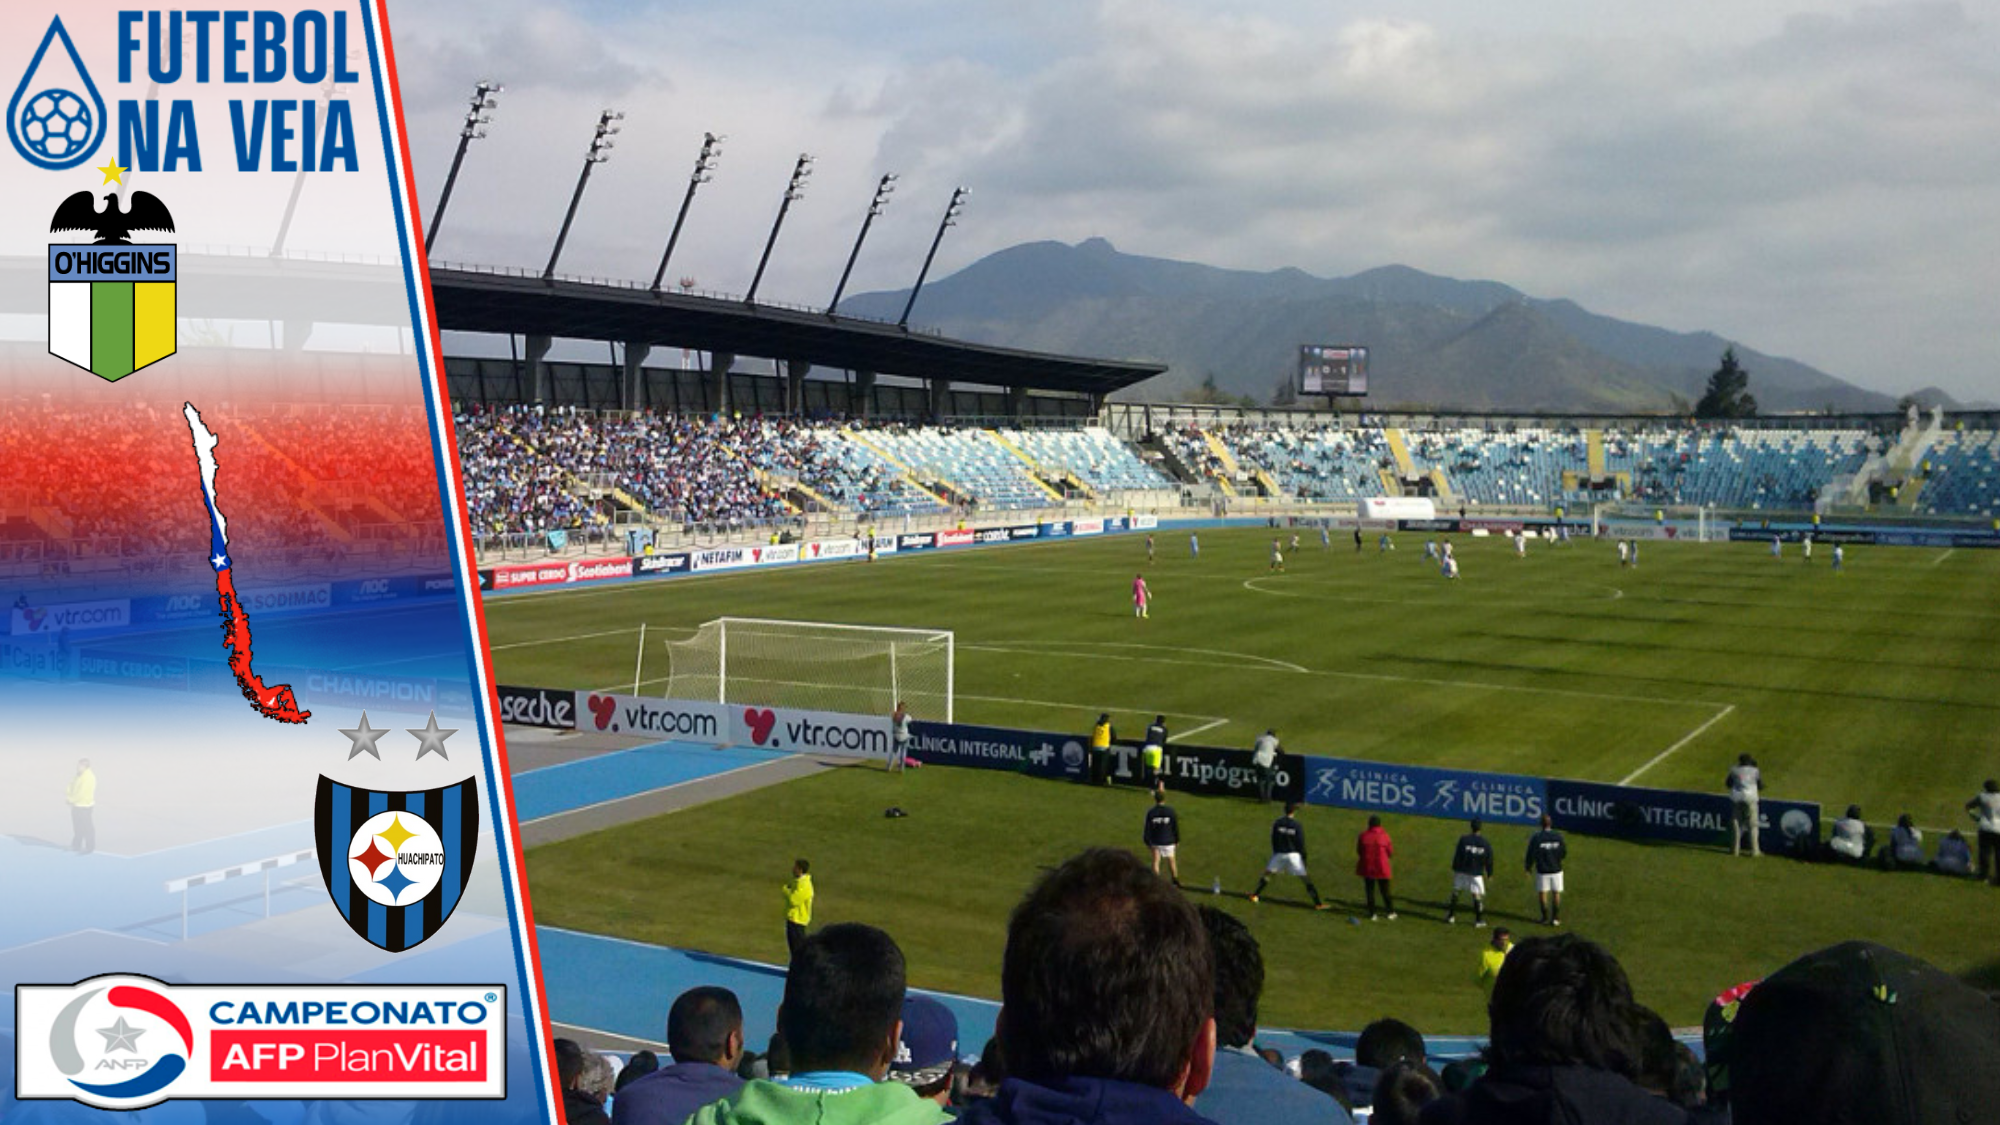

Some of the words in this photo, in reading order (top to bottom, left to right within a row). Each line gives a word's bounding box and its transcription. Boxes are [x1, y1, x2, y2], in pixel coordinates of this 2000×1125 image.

[701, 549, 743, 565] NETAFIM
[765, 547, 794, 560] vtr.com
[577, 561, 633, 579] Scotiabank
[255, 588, 328, 610] SODIMAC
[54, 605, 122, 626] vtr.com
[13, 645, 46, 675] Caja
[81, 656, 118, 677] SUPER
[122, 659, 163, 680] CERDO
[307, 674, 433, 703] CHAMPION
[499, 690, 575, 728] seche
[625, 704, 717, 737] vtr.com
[787, 721, 889, 753] vtr.com
[959, 739, 1026, 762] INTEGRAL
[1176, 755, 1291, 789] Tipógro
[1341, 778, 1416, 808] MEDS
[1462, 790, 1543, 820] MEDS
[1554, 795, 1616, 821] CLÍNIC
[1640, 805, 1727, 832] NTEGRAL
